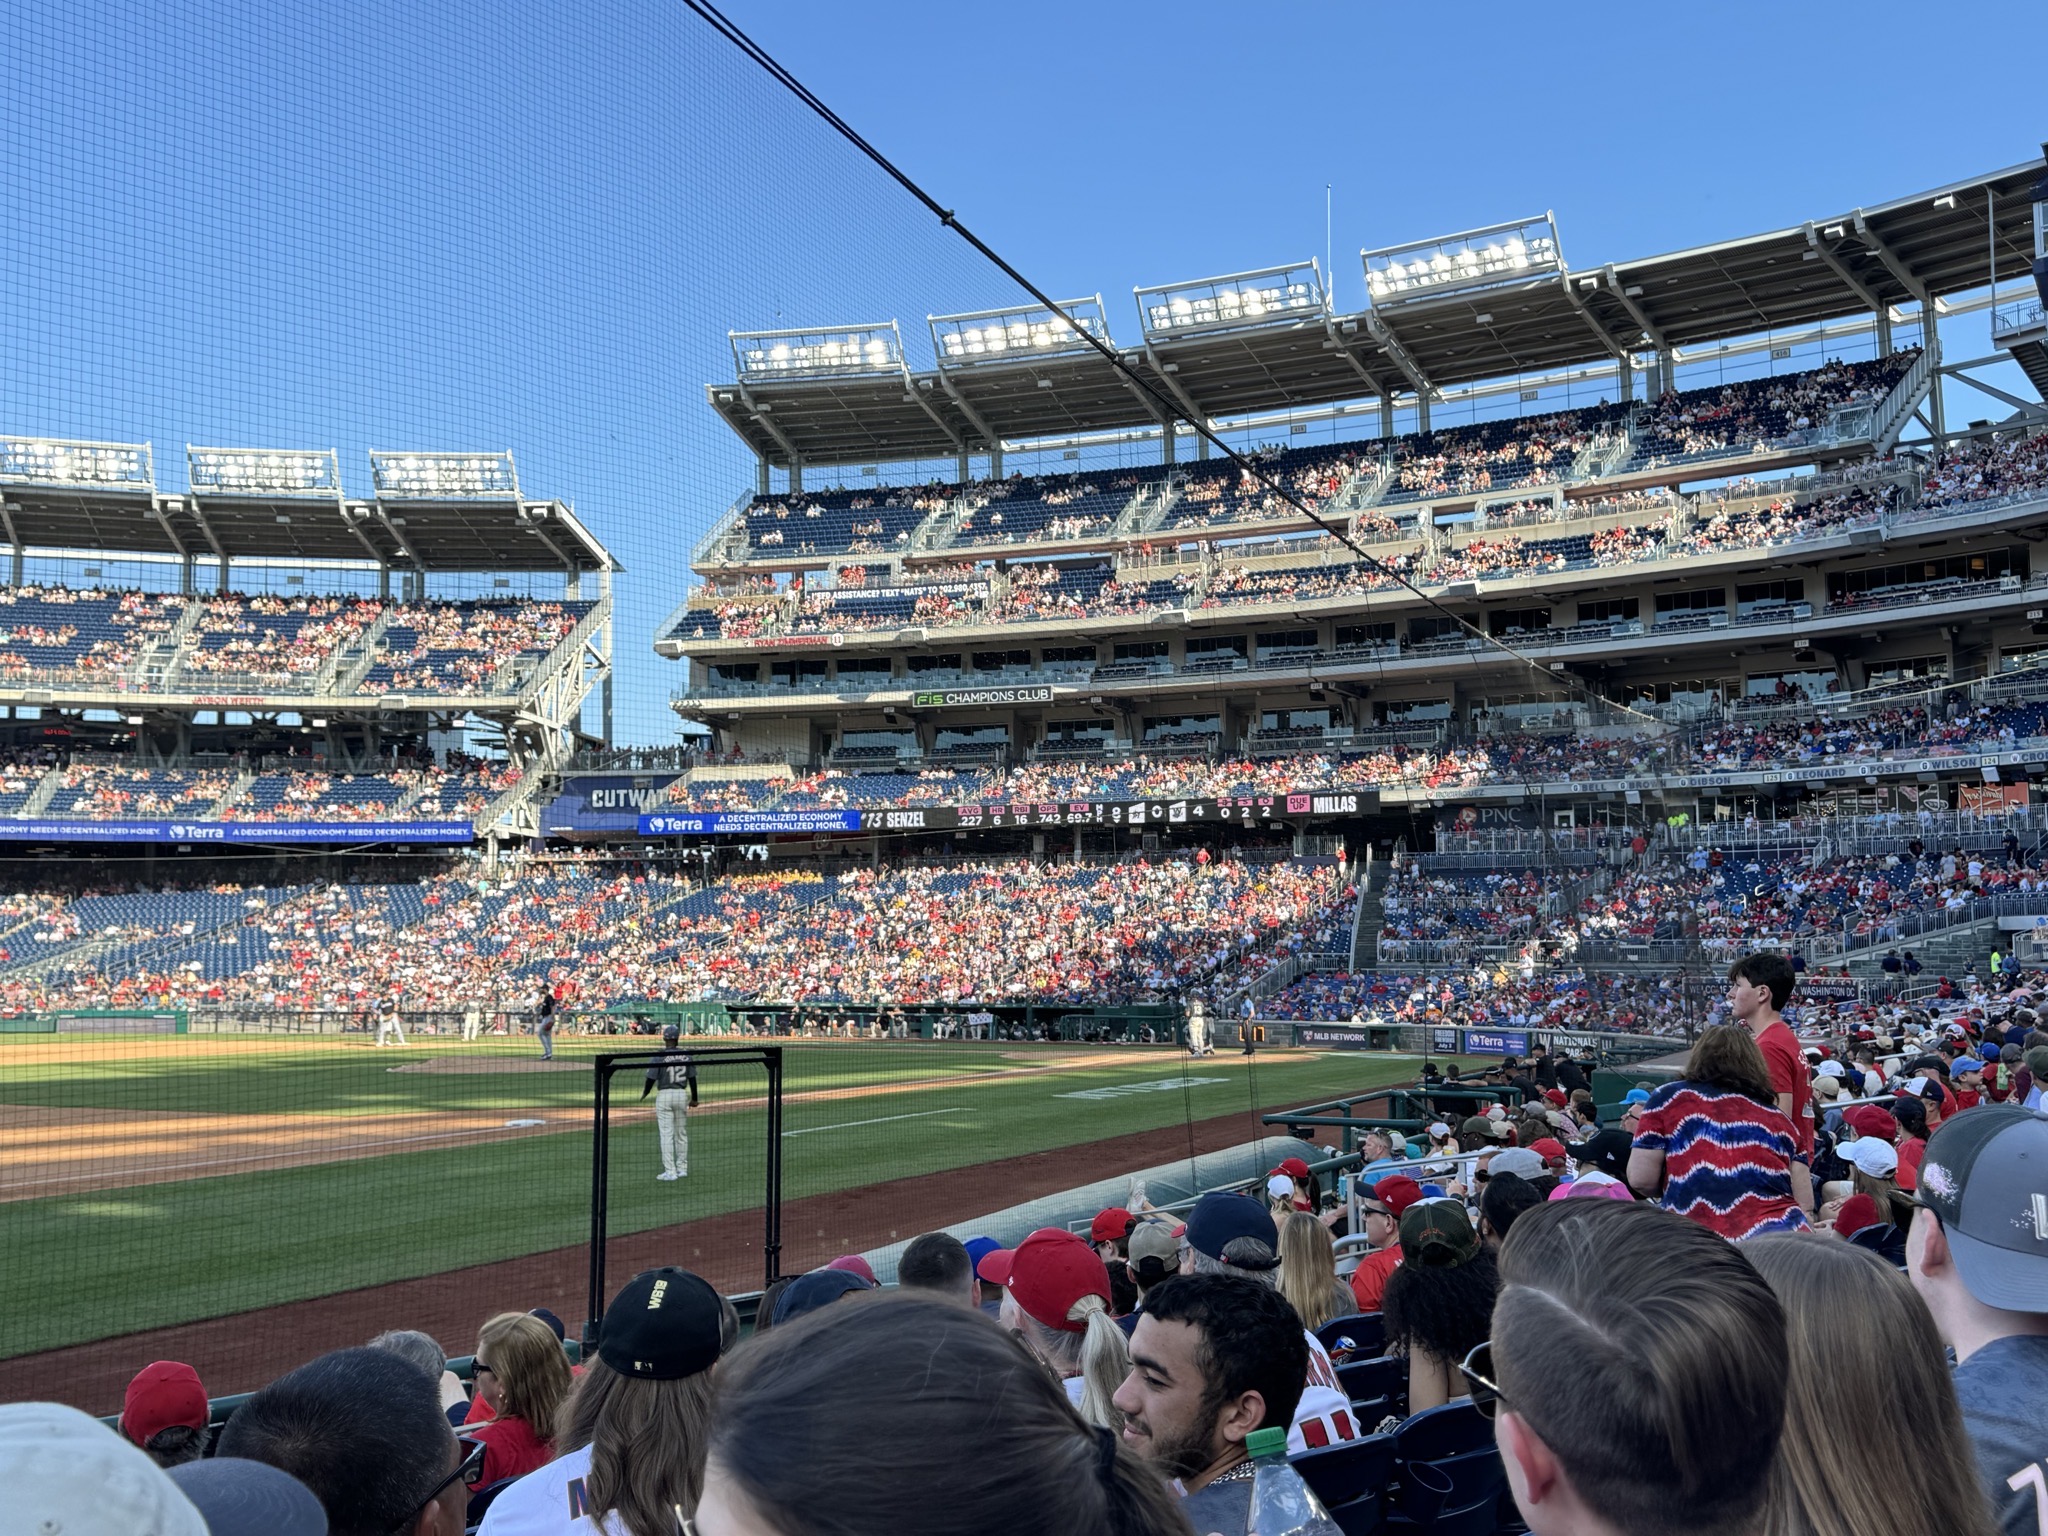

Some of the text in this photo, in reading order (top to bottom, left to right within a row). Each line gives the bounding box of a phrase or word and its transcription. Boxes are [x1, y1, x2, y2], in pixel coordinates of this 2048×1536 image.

[833, 589, 880, 600] ASSISTANCE?
[881, 588, 900, 597] TEXT
[927, 585, 938, 594] TO
[946, 689, 1014, 704] CHAMPIONS
[1017, 688, 1049, 700] CLUB
[1931, 758, 1977, 770] WILSON
[1984, 757, 1996, 765] 124
[1796, 768, 1846, 780] LEONARD
[1869, 763, 1908, 774] POSEY
[1581, 783, 1607, 792] BELL
[1690, 776, 1731, 787] GIBSON
[1435, 788, 1485, 799] RODRIGUEZ
[1289, 796, 1308, 804] DUE
[1292, 802, 1305, 810] UP
[1313, 795, 1357, 813] MILLAS
[960, 803, 1085, 815] AVG HR RBI OPS EV
[1192, 805, 1205, 817] 4
[1241, 807, 1251, 818] 2
[1261, 806, 1271, 817] 2
[1480, 807, 1522, 823] PNC
[719, 812, 843, 823] A DECENTRALIZED ECONOMY
[886, 810, 926, 828] SENZEL
[957, 811, 1092, 827] .227 6 16 .742 69.7
[664, 817, 703, 831] Terra
[713, 820, 849, 832] NEEDS DECENTRALIZED MONEY.
[30, 826, 58, 834] NEEDS
[59, 827, 128, 835] DECENTRALIZED
[130, 827, 160, 836] MONEY.
[185, 825, 225, 839] Terra
[232, 828, 469, 836] A DECENTRALIZED ECONOMY NEEDS DECENTRALIZED MONEY.
[1800, 986, 1844, 997] WASHINGTON
[1845, 988, 1855, 997] DC
[1314, 1032, 1330, 1041] MLB
[1330, 1033, 1366, 1042] NETWORK
[1480, 1035, 1504, 1047] Terra
[1553, 1036, 1598, 1048] NATIONALS
[665, 1065, 687, 1084] 12
